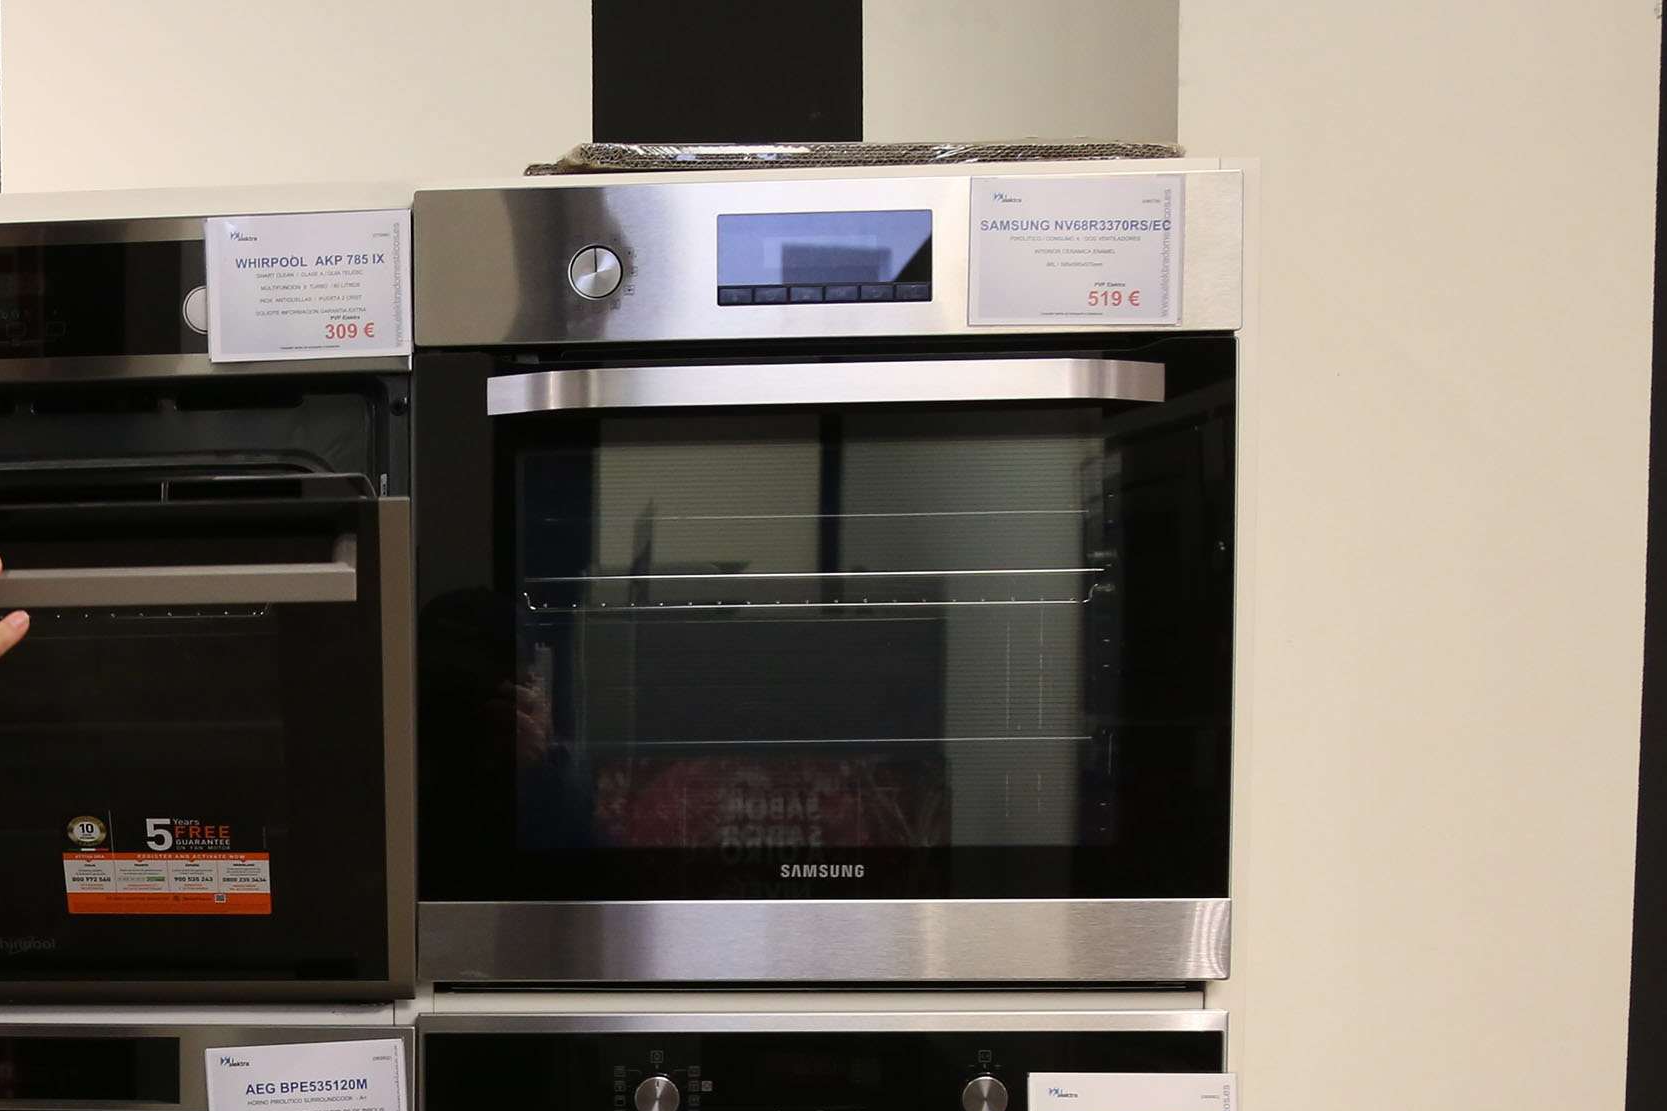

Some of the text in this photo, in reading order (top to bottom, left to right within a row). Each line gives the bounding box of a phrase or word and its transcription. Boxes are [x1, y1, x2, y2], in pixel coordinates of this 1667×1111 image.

[980, 220, 1172, 231] SAMSUNG NV68R3370RS/EC
[235, 253, 385, 269] WHIRPOOL AKP 785 IX
[1088, 291, 1140, 307] 519 €
[325, 322, 375, 340] 309 €
[79, 824, 94, 834] 10
[145, 818, 200, 851] 5 Years
[175, 826, 231, 838] FREE
[780, 864, 865, 878] SAMSUNG
[245, 1078, 368, 1095] AEG BPE535120M
